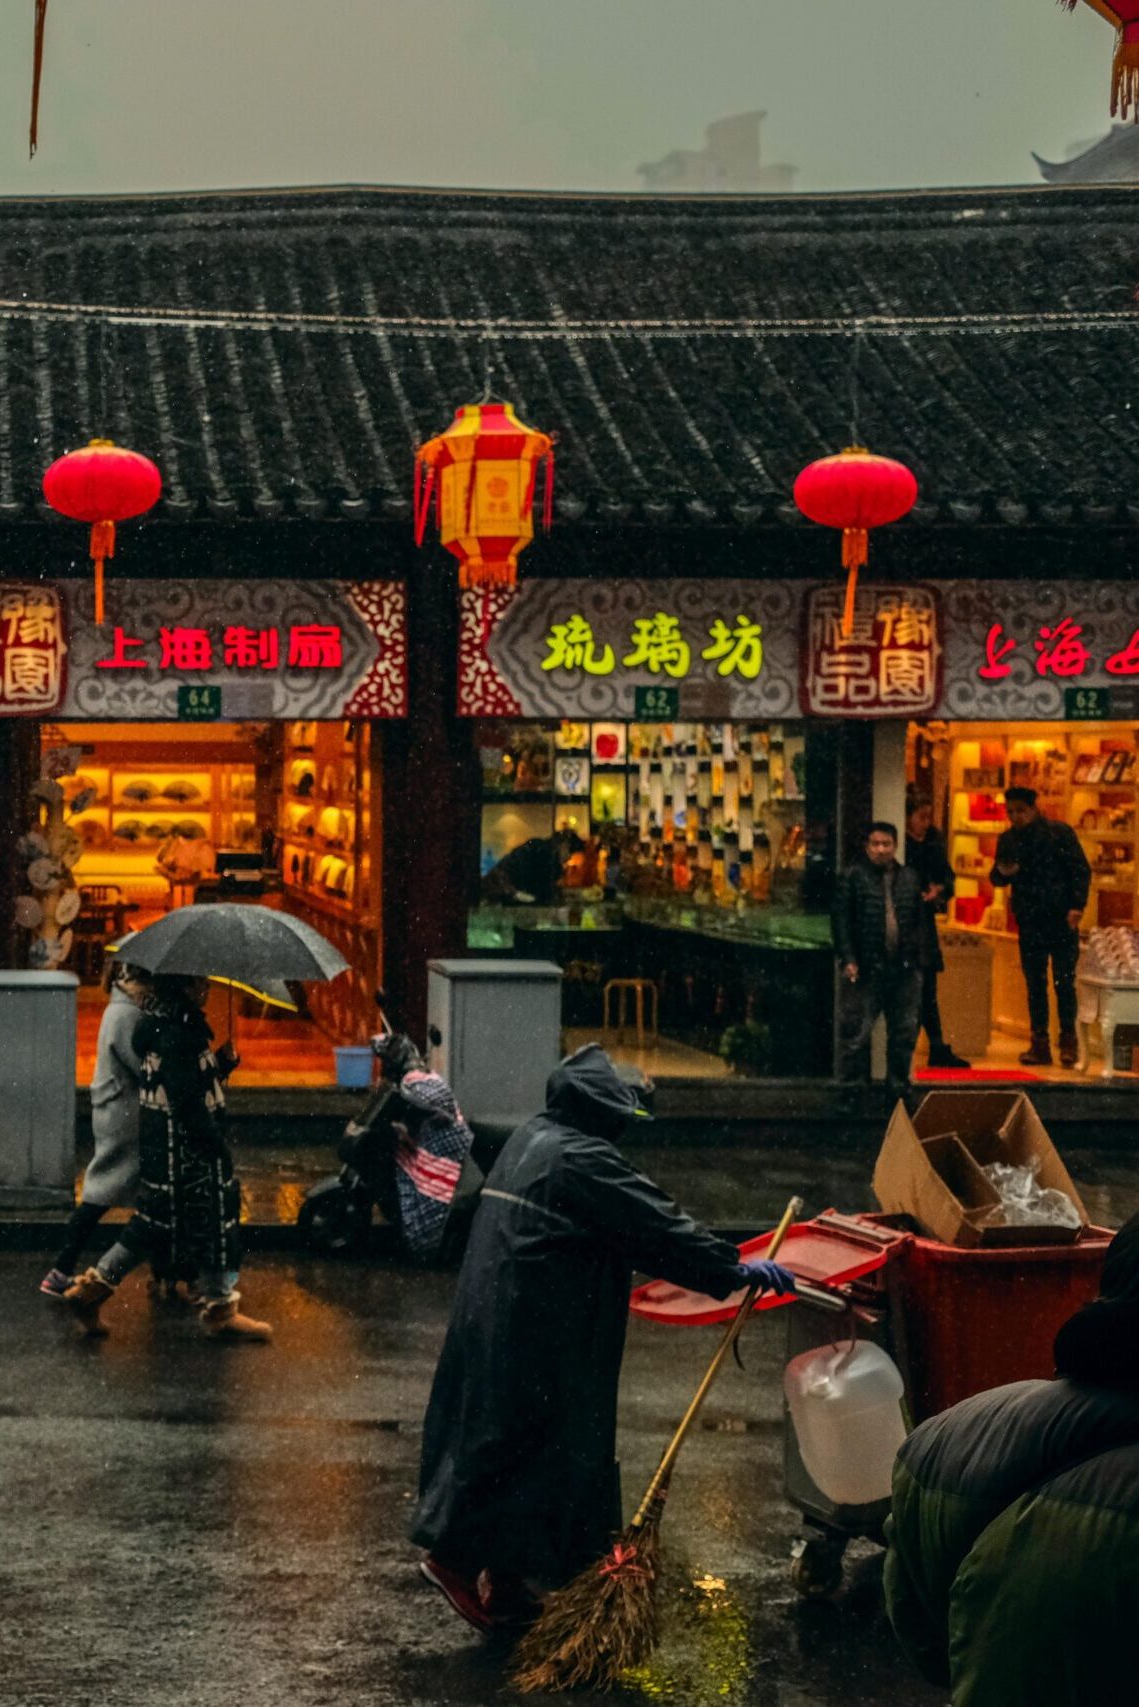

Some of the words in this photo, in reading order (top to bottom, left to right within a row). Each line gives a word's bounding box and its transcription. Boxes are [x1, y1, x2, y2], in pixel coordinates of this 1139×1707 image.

[94, 624, 344, 670] 上海制扇
[541, 611, 762, 679] 琉璃坊
[188, 688, 211, 706] 64
[644, 690, 668, 708] 62
[1075, 690, 1098, 709] 62
